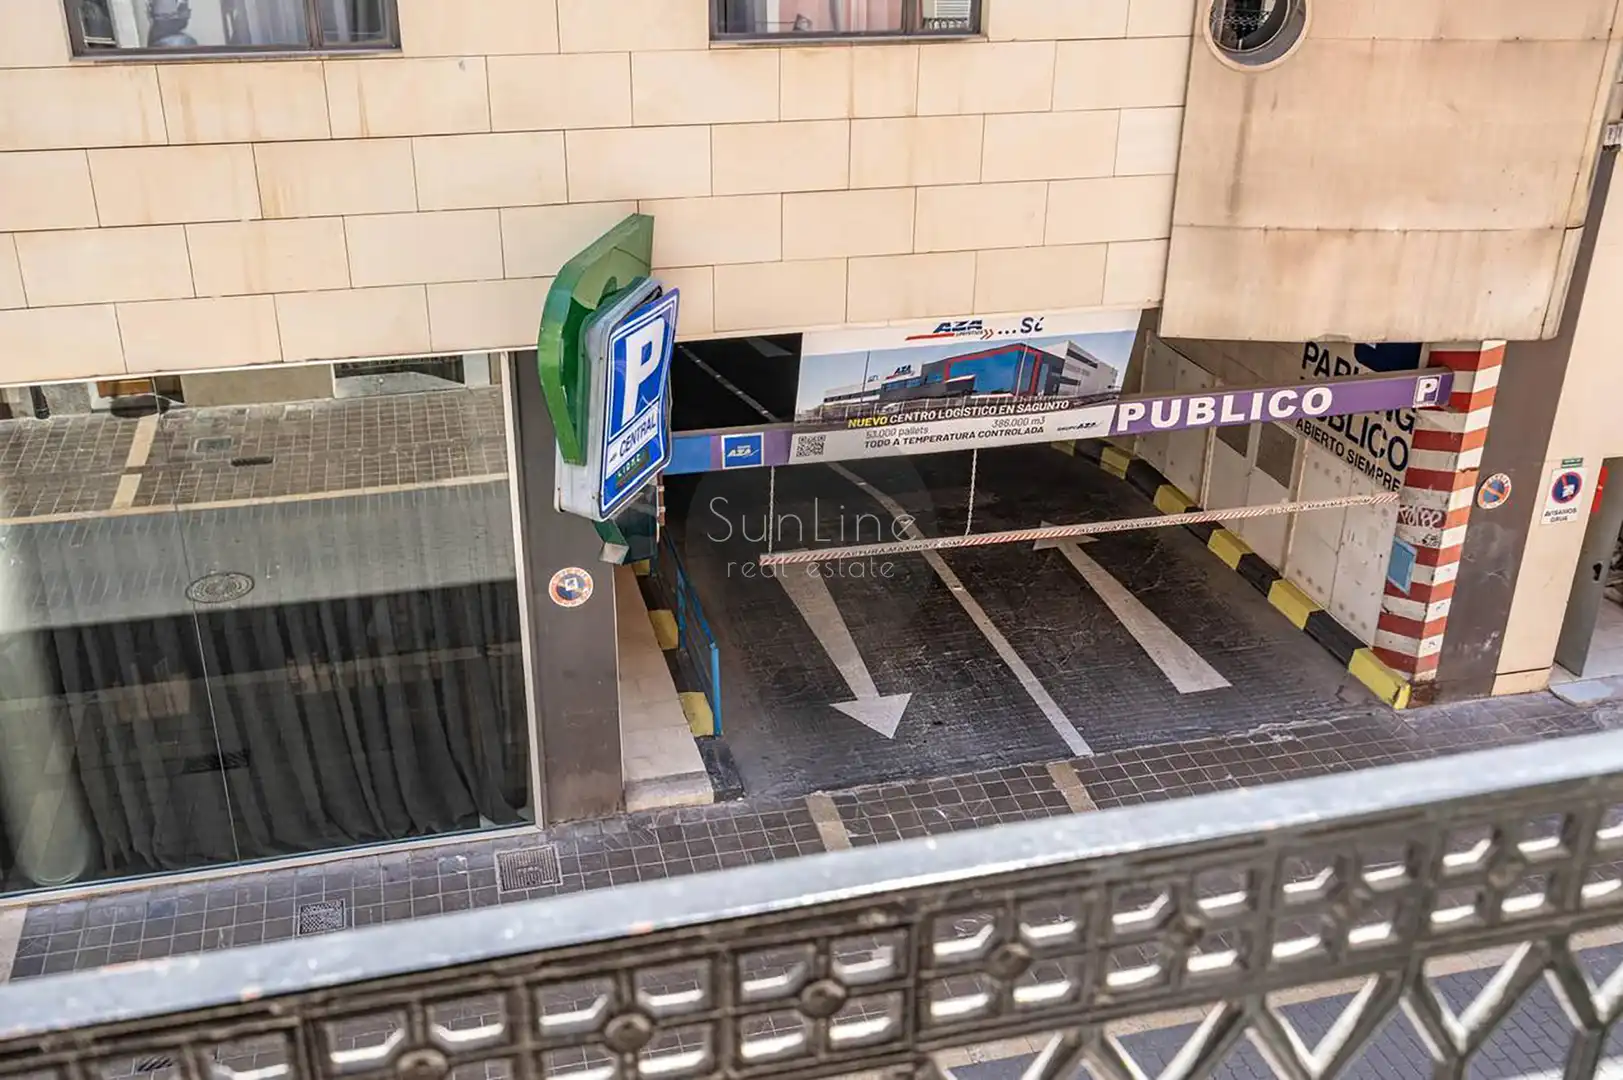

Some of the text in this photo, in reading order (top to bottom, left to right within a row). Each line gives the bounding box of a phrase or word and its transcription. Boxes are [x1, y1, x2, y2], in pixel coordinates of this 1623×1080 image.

[933, 320, 982, 333] AZA
[621, 317, 665, 427] P
[1416, 378, 1438, 403] P
[848, 415, 888, 428] NUEVO
[889, 410, 936, 424] CENTRO
[998, 404, 1015, 416] EN
[1016, 400, 1070, 413] SAGUNTO
[1031, 417, 1046, 426] m3
[1117, 387, 1333, 432] PUBLICO
[620, 413, 656, 457] CENTRAL
[865, 426, 1045, 449] TODO A TEMPERATURA CONTROLADA
[899, 426, 929, 437] pallets
[1296, 419, 1401, 492] ABIERTO SIEMPRE
